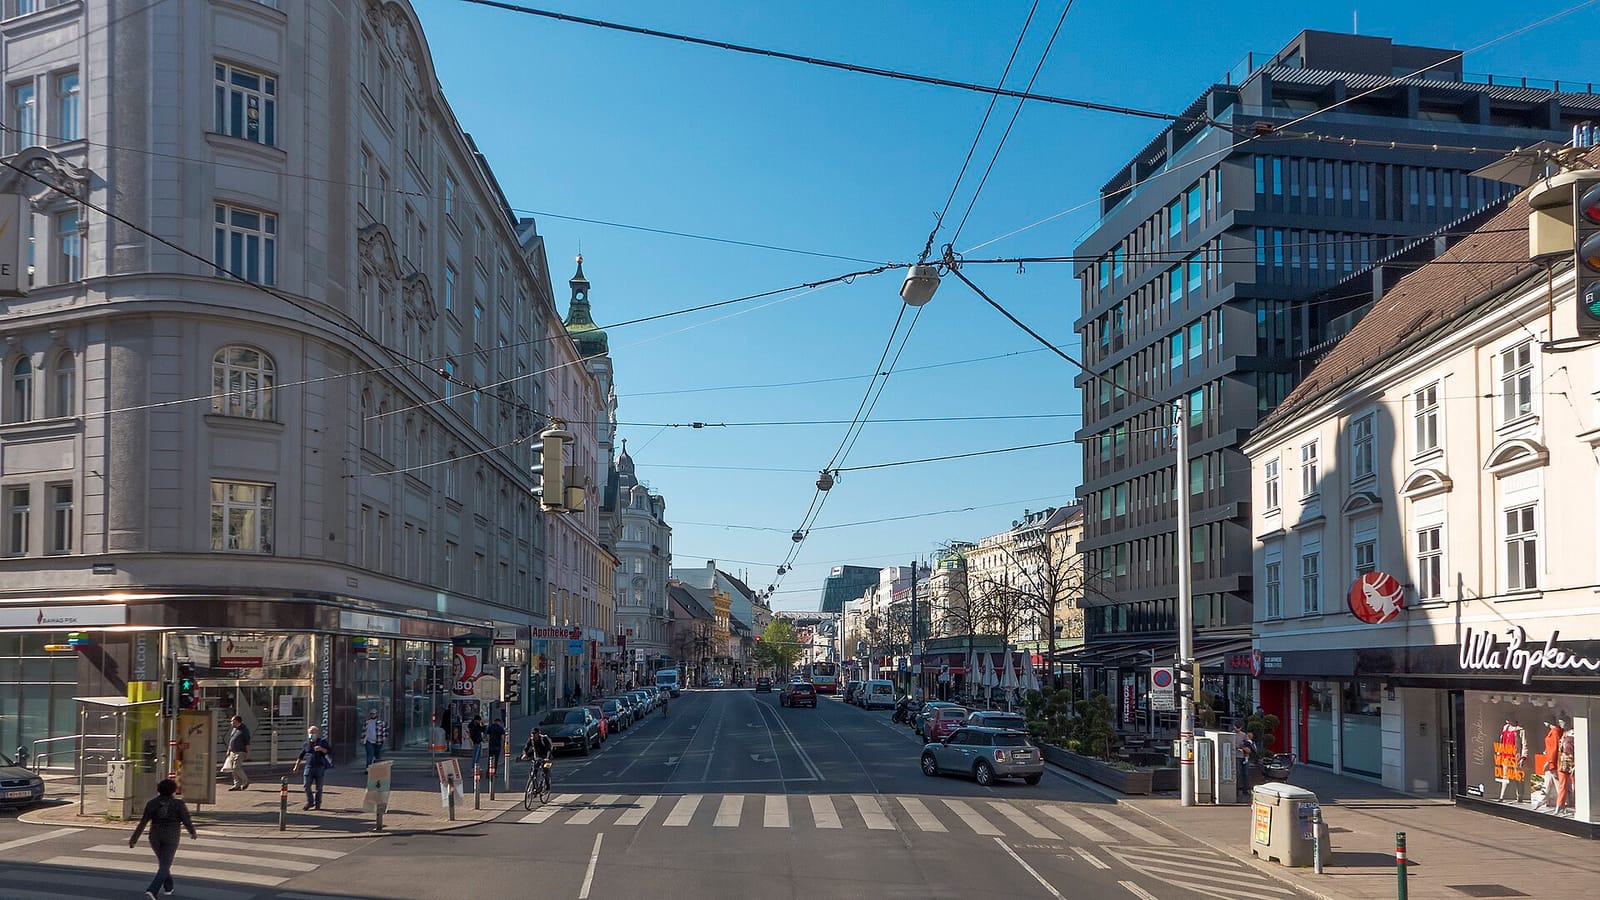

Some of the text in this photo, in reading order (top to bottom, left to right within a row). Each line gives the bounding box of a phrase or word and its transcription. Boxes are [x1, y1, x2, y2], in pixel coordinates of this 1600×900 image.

[0, 263, 10, 276] E
[533, 627, 569, 638] Apotheke
[1460, 625, 1600, 685] Ulla Popken
[1495, 766, 1504, 778] DU
